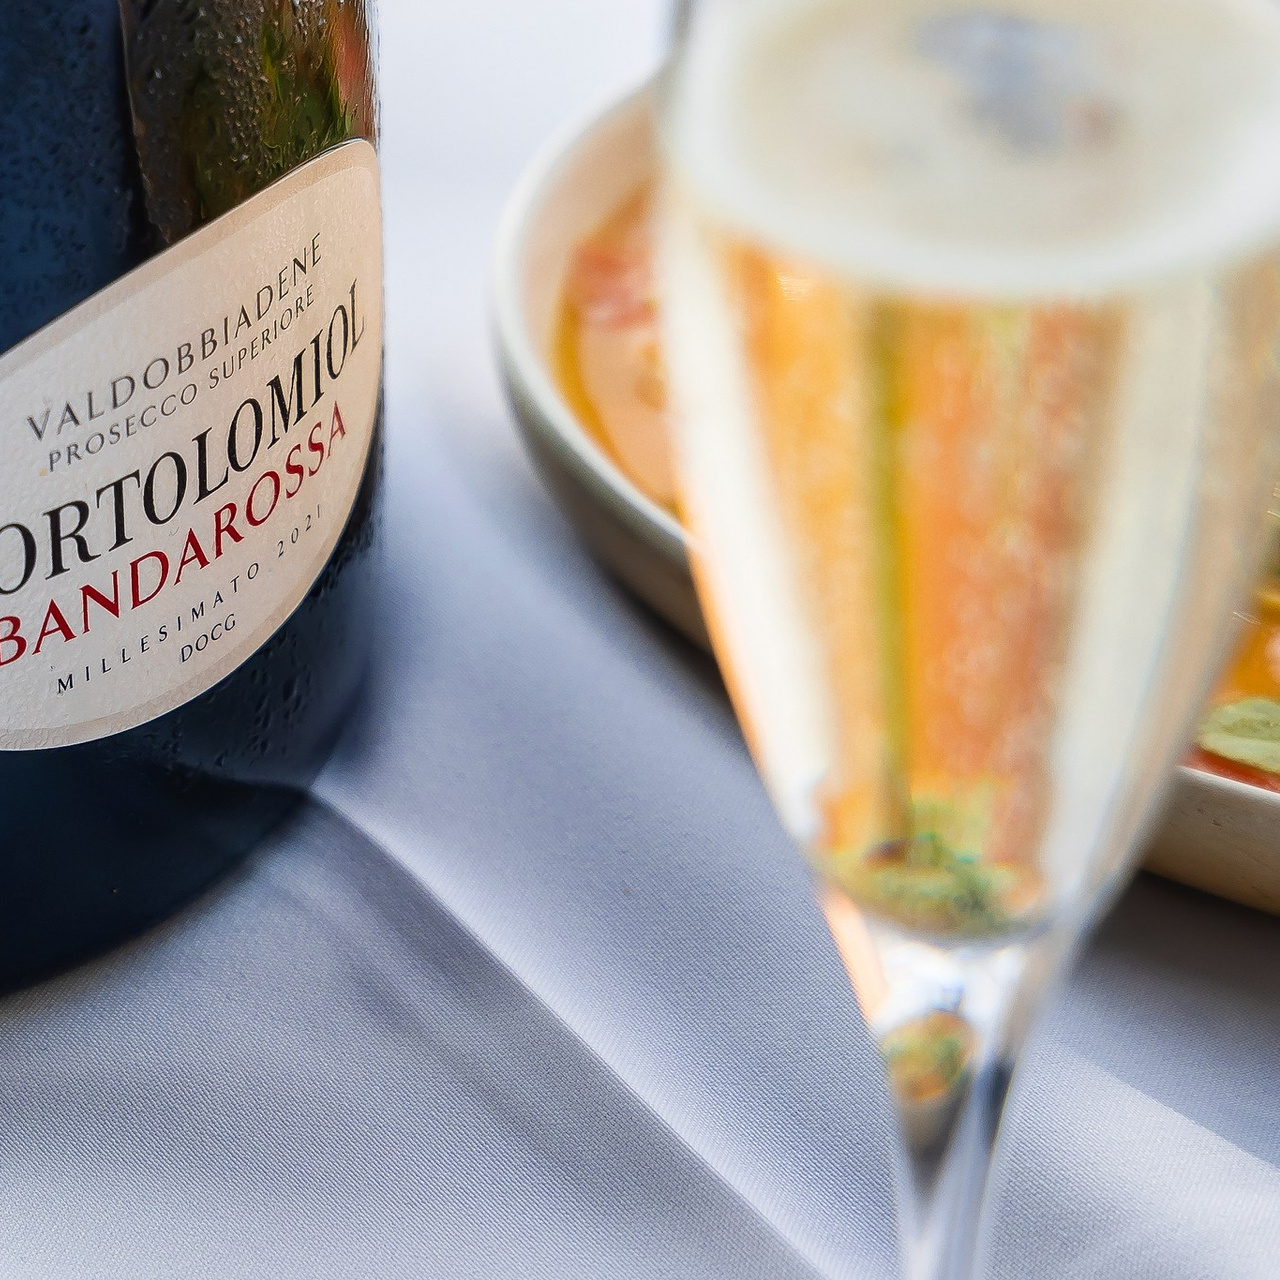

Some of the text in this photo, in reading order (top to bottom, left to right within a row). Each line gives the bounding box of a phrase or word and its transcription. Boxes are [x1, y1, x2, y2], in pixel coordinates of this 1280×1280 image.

[26, 232, 322, 442] VALDOBBIADENE
[48, 283, 315, 472] PROSECCO SUPERIORE
[56, 503, 321, 695] MILLESIMATO 2021
[179, 613, 237, 663] DOCG
